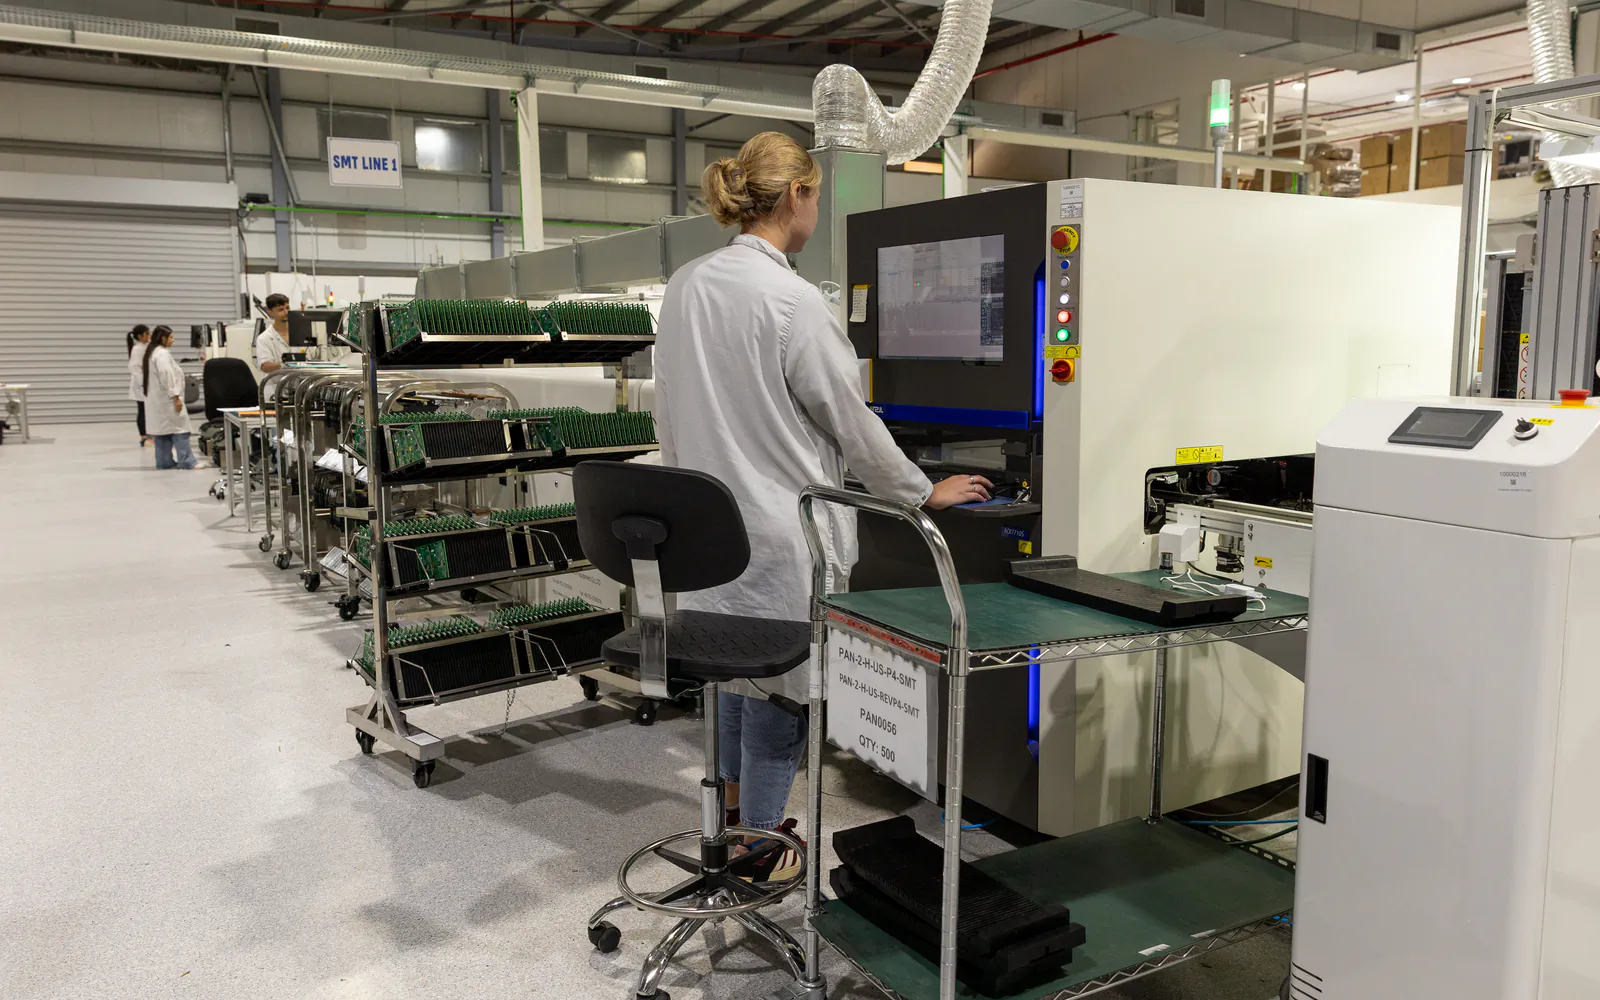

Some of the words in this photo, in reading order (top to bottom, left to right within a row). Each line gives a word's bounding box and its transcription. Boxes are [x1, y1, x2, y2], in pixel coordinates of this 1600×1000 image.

[333, 155, 358, 169] SMT
[362, 156, 388, 171] LINE
[391, 158, 398, 171] 1
[838, 647, 917, 690] PAN-2-H-US-P4-SMT
[839, 673, 920, 719] PAN-2-H-US-REVP4-SMT
[860, 708, 897, 735] PAN0056
[858, 734, 879, 754] QTY:
[881, 745, 896, 763] 500
